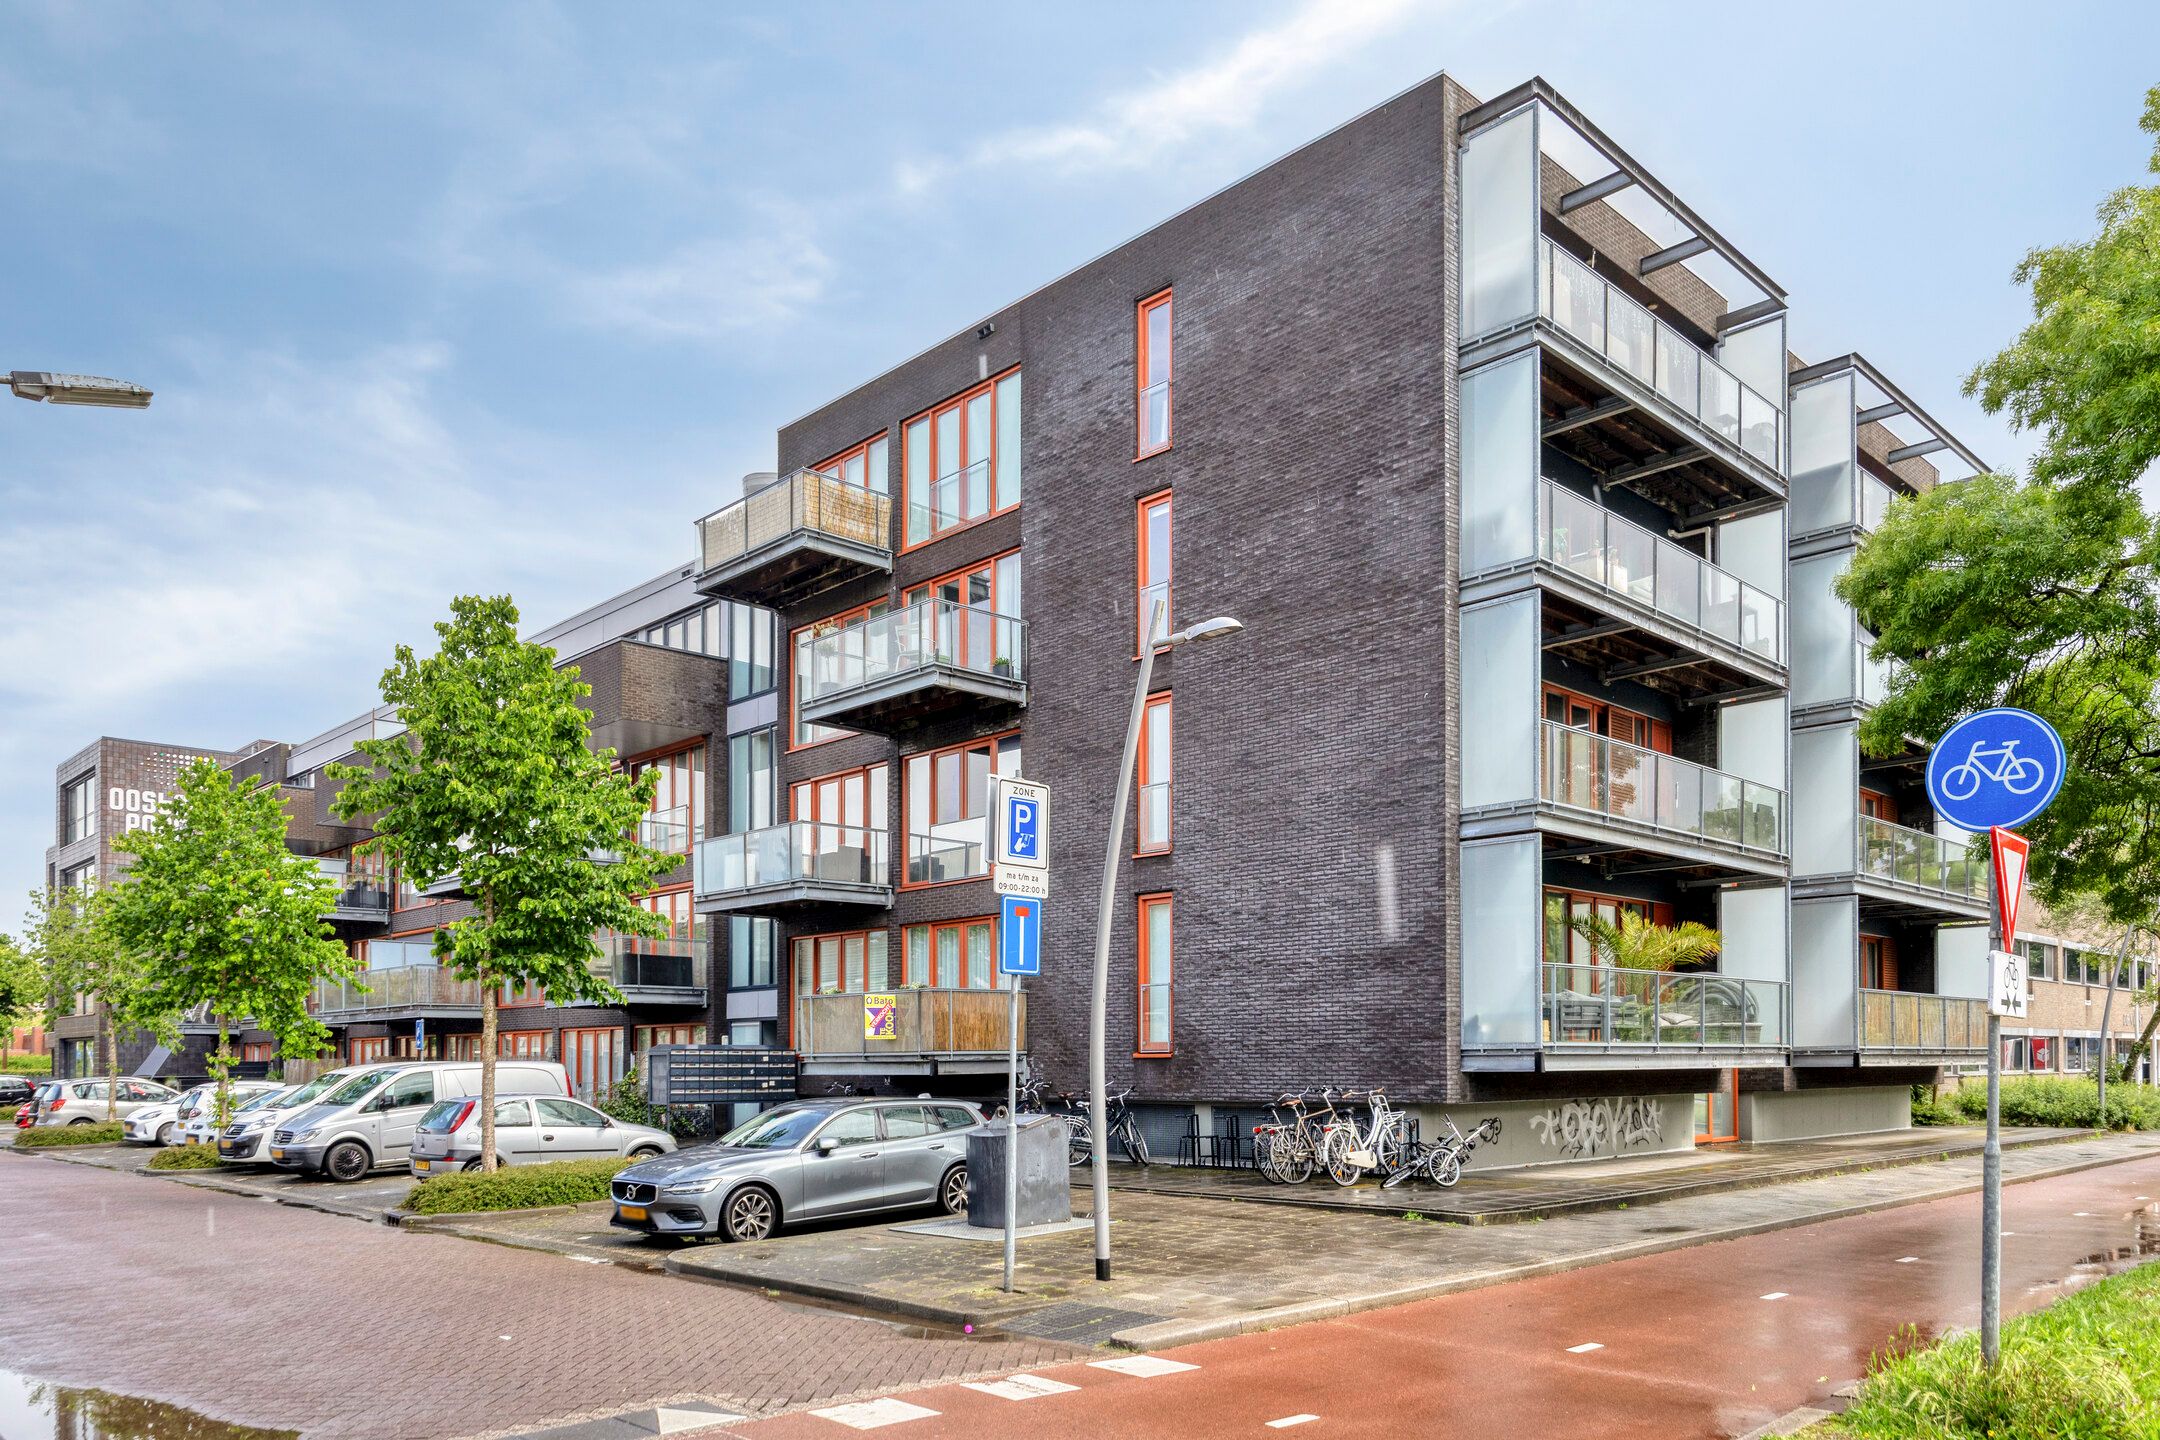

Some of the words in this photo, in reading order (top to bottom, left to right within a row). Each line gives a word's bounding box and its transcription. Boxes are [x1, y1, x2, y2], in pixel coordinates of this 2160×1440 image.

[1013, 786, 1036, 798] ZONE
[1015, 803, 1032, 834] P
[1006, 872, 1016, 880] ma
[1018, 873, 1030, 881] t/m
[1031, 875, 1039, 883] za
